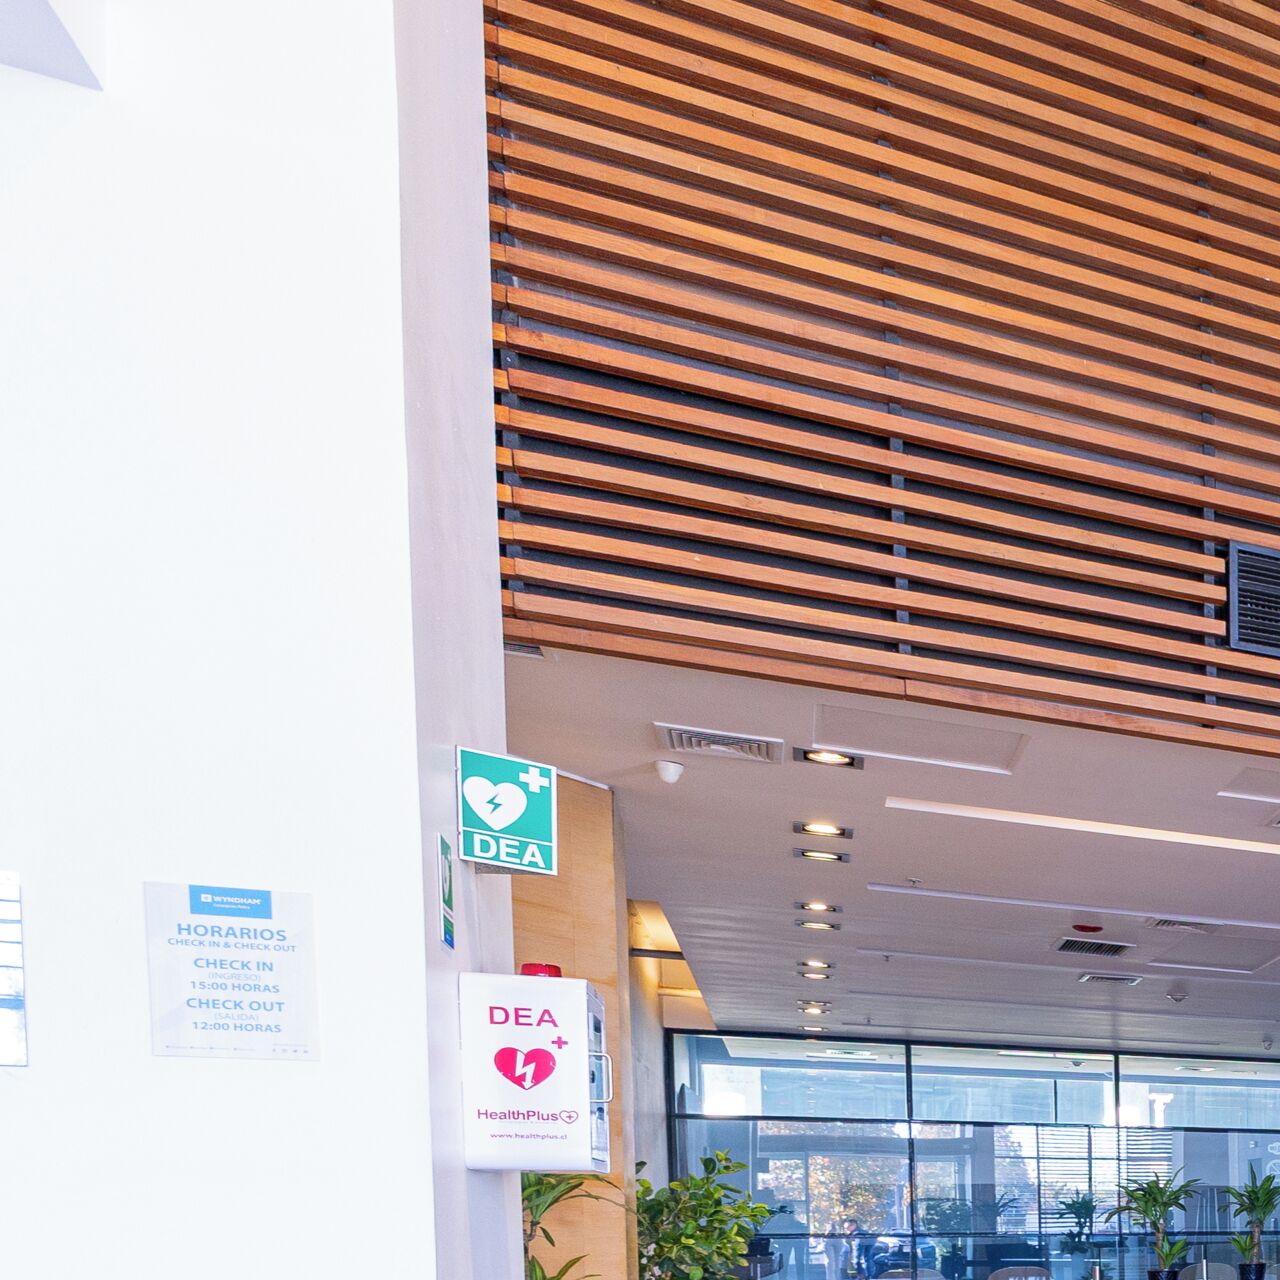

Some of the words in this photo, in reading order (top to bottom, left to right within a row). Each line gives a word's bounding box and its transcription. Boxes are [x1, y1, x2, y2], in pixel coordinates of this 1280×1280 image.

[473, 833, 546, 869] DEA
[177, 923, 287, 942] HORARIOS
[168, 938, 206, 948] CHECK
[209, 941, 221, 949] IN
[234, 942, 271, 951] CHECK
[274, 944, 297, 953] OUT
[194, 958, 252, 971] CHECK
[257, 961, 274, 972] IN
[208, 972, 261, 982] (INGRESO)
[190, 981, 228, 991] 15:00
[231, 983, 280, 993] HORAS
[186, 998, 244, 1010] CHECK
[249, 1001, 285, 1012] OUT
[214, 1012, 259, 1022] (SALIDA)
[489, 1006, 559, 1028] DEA
[192, 1022, 229, 1031] 12:00
[234, 1023, 282, 1033] HORAS
[477, 1109, 559, 1122] HealthPlus
[490, 1132, 568, 1141] www.healthplus.cl
